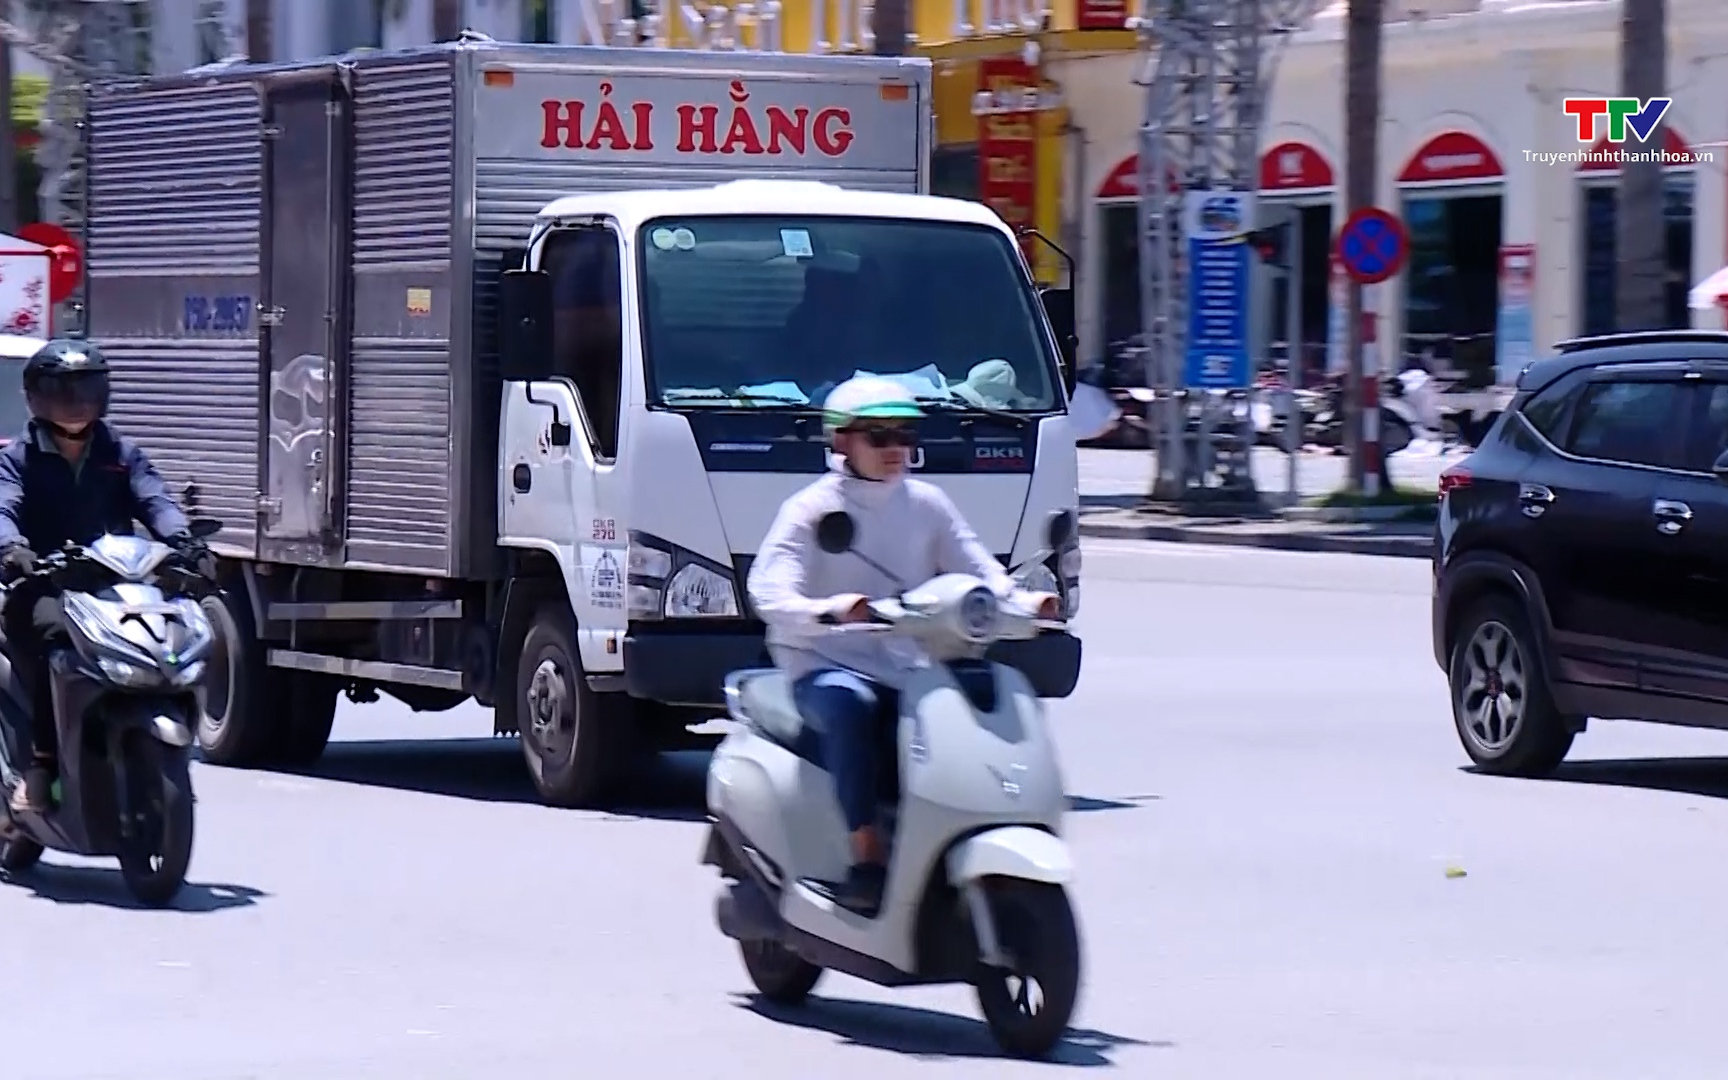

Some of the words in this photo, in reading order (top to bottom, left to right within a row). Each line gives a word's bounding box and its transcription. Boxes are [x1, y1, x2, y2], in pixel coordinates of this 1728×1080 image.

[540, 82, 654, 151] HẢI
[675, 80, 854, 156] HẰNG
[592, 529, 616, 540] 270
